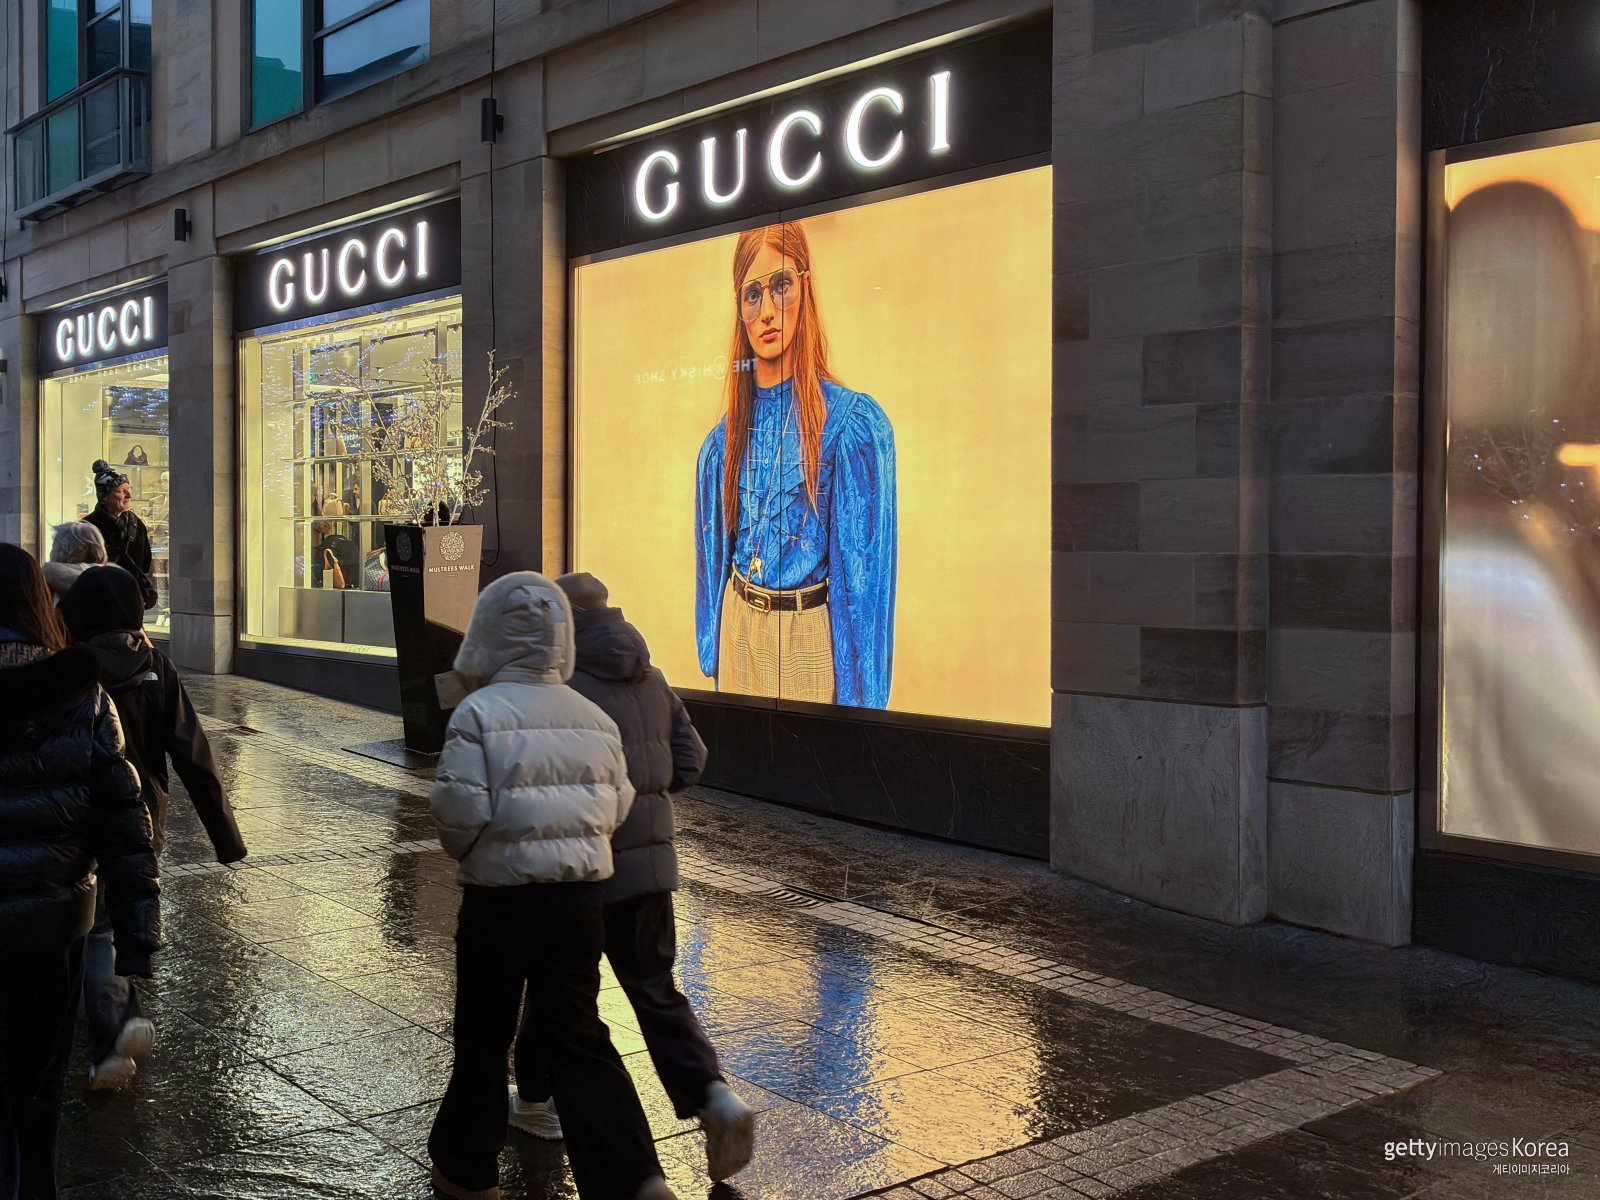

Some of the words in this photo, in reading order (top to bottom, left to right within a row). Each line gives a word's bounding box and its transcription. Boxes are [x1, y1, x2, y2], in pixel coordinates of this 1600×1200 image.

[634, 70, 952, 220] GUCCI
[268, 221, 430, 311] GUCCI
[55, 296, 155, 361] GUCCI
[428, 565, 458, 573] MULTREES
